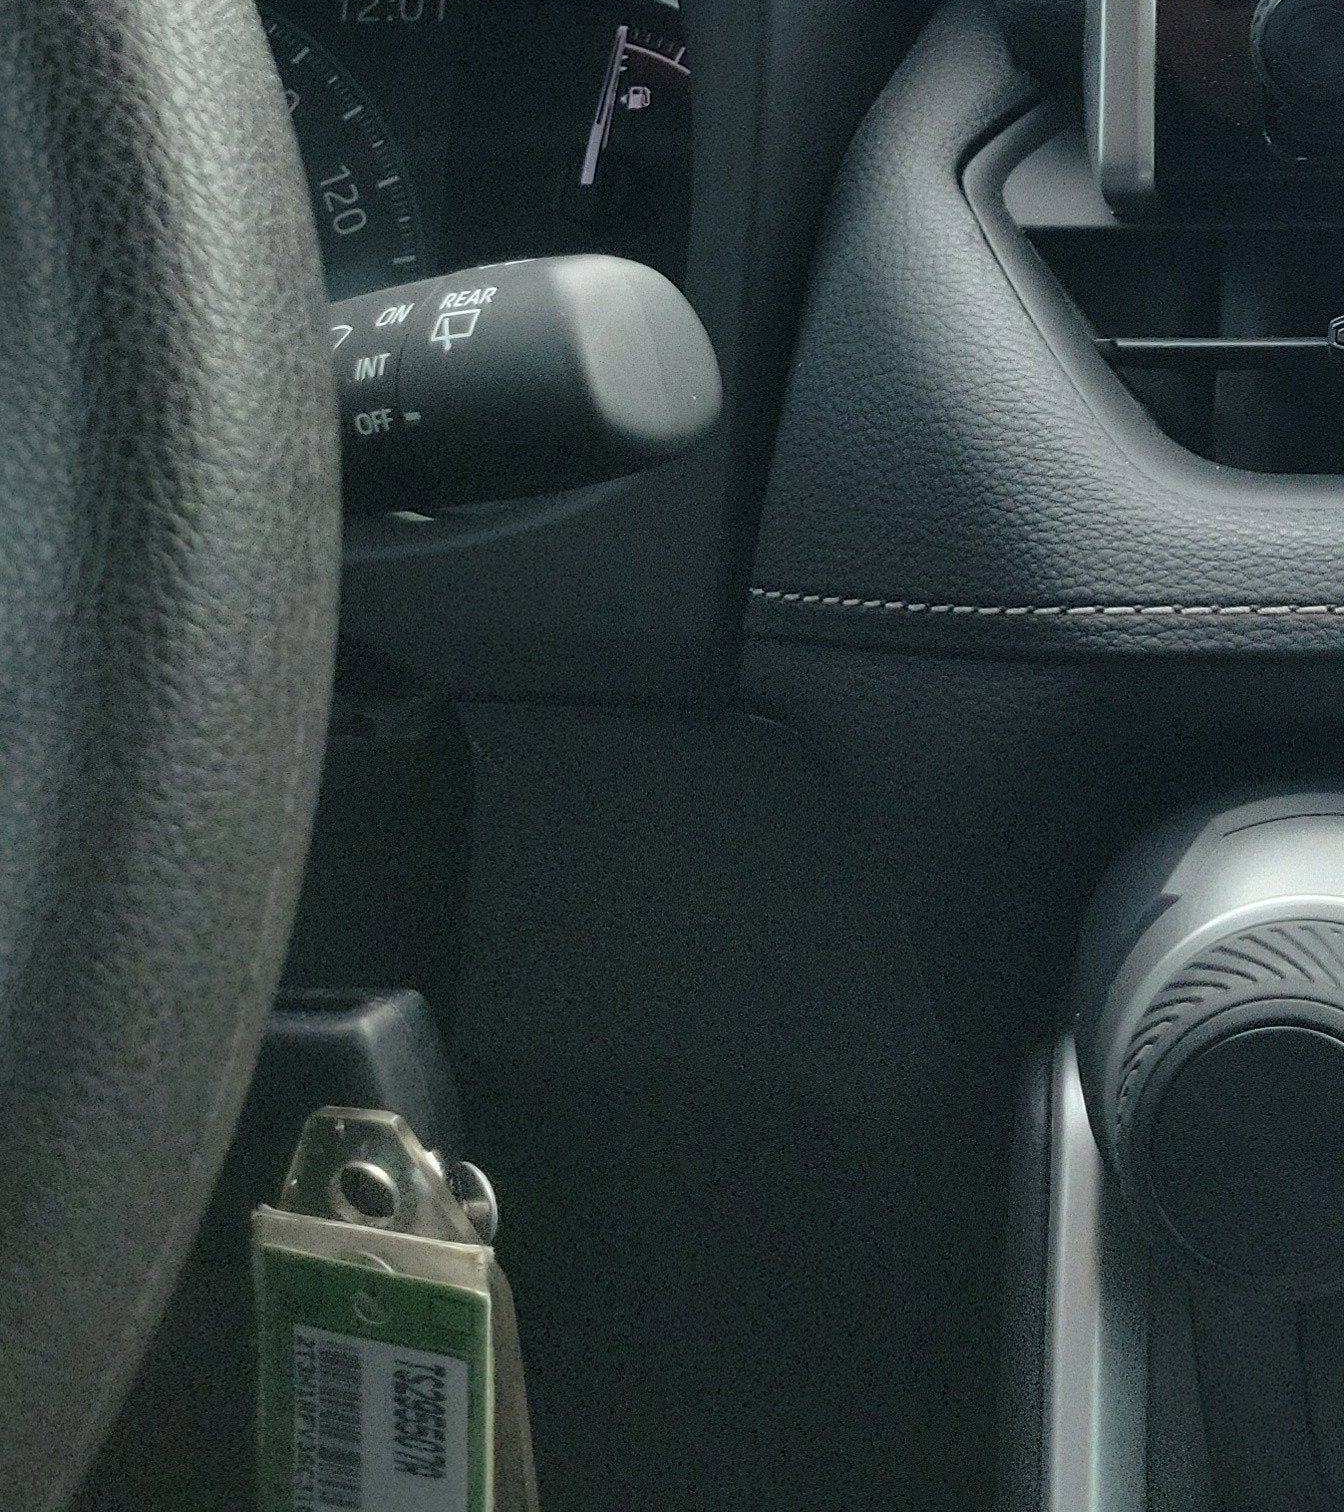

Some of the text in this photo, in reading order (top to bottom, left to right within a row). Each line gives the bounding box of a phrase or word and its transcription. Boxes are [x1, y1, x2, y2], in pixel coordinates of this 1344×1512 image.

[320, 164, 367, 235] 120
[439, 287, 498, 310] REAR
[376, 303, 415, 327] ON
[354, 352, 391, 381] INT
[354, 408, 394, 435] OFF
